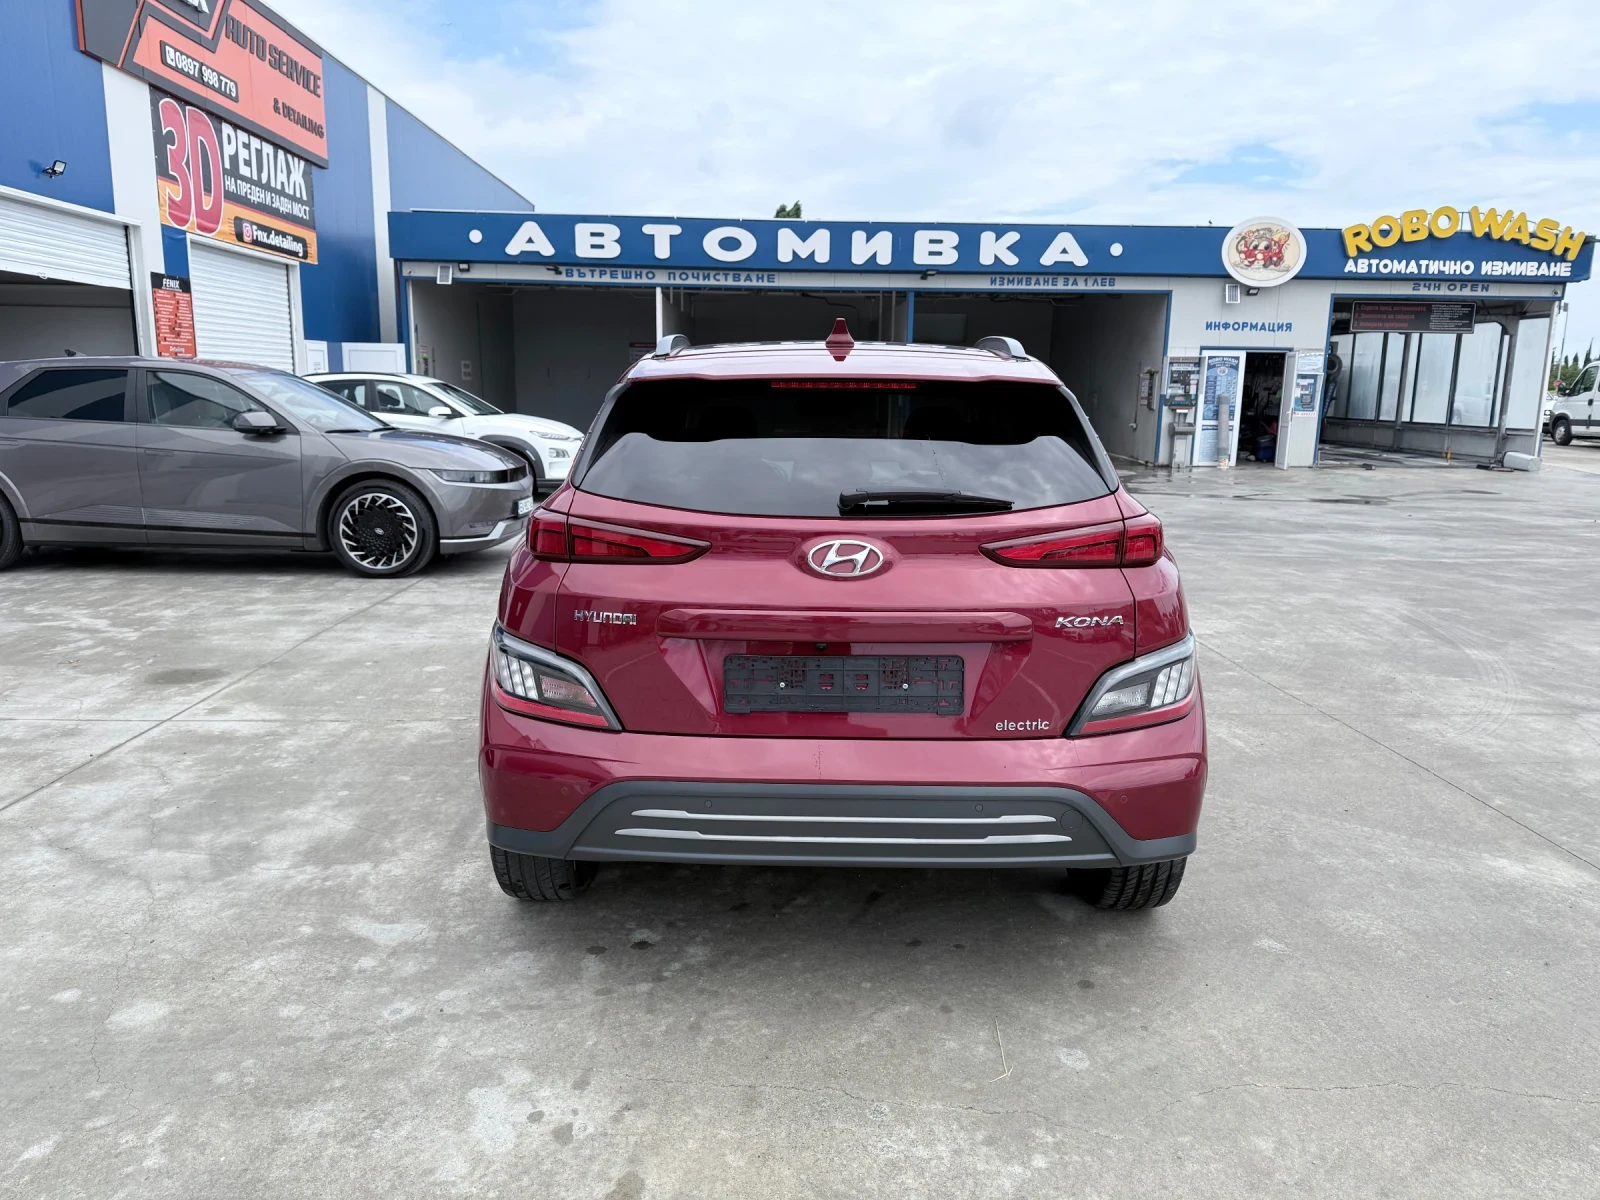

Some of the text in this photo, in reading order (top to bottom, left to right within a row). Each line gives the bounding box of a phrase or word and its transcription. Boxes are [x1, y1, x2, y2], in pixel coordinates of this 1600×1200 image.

[225, 14, 321, 98] AUTO SERVICE
[175, 51, 237, 98] 0897 998 779
[273, 98, 324, 139] & DETAILING
[158, 98, 224, 238] 3D
[222, 121, 308, 201] РЕГЛАЖ
[225, 175, 310, 220] НА ПРЕДЕН И ЗАДЕН МОСТ
[1341, 205, 1586, 262] ROBO WASH
[504, 221, 1089, 267] АВТОМИВКА
[564, 268, 777, 284] ВЪТРЕШНО ПОЧИСТВАНЕ
[1343, 258, 1572, 278] АВТОМАТИЧНО ИЗМИВАНЕ
[162, 278, 180, 289] FENIX
[989, 276, 1116, 288] ИЗМИВАНЕ ЗА 1 ЛЕВ
[1412, 282, 1491, 293] 24H OPEN
[1205, 321, 1293, 333] ИНФОРМАЦИЯ
[573, 609, 637, 625] HYUNDAI
[1054, 614, 1125, 628] KONA
[995, 718, 1050, 731] electric
